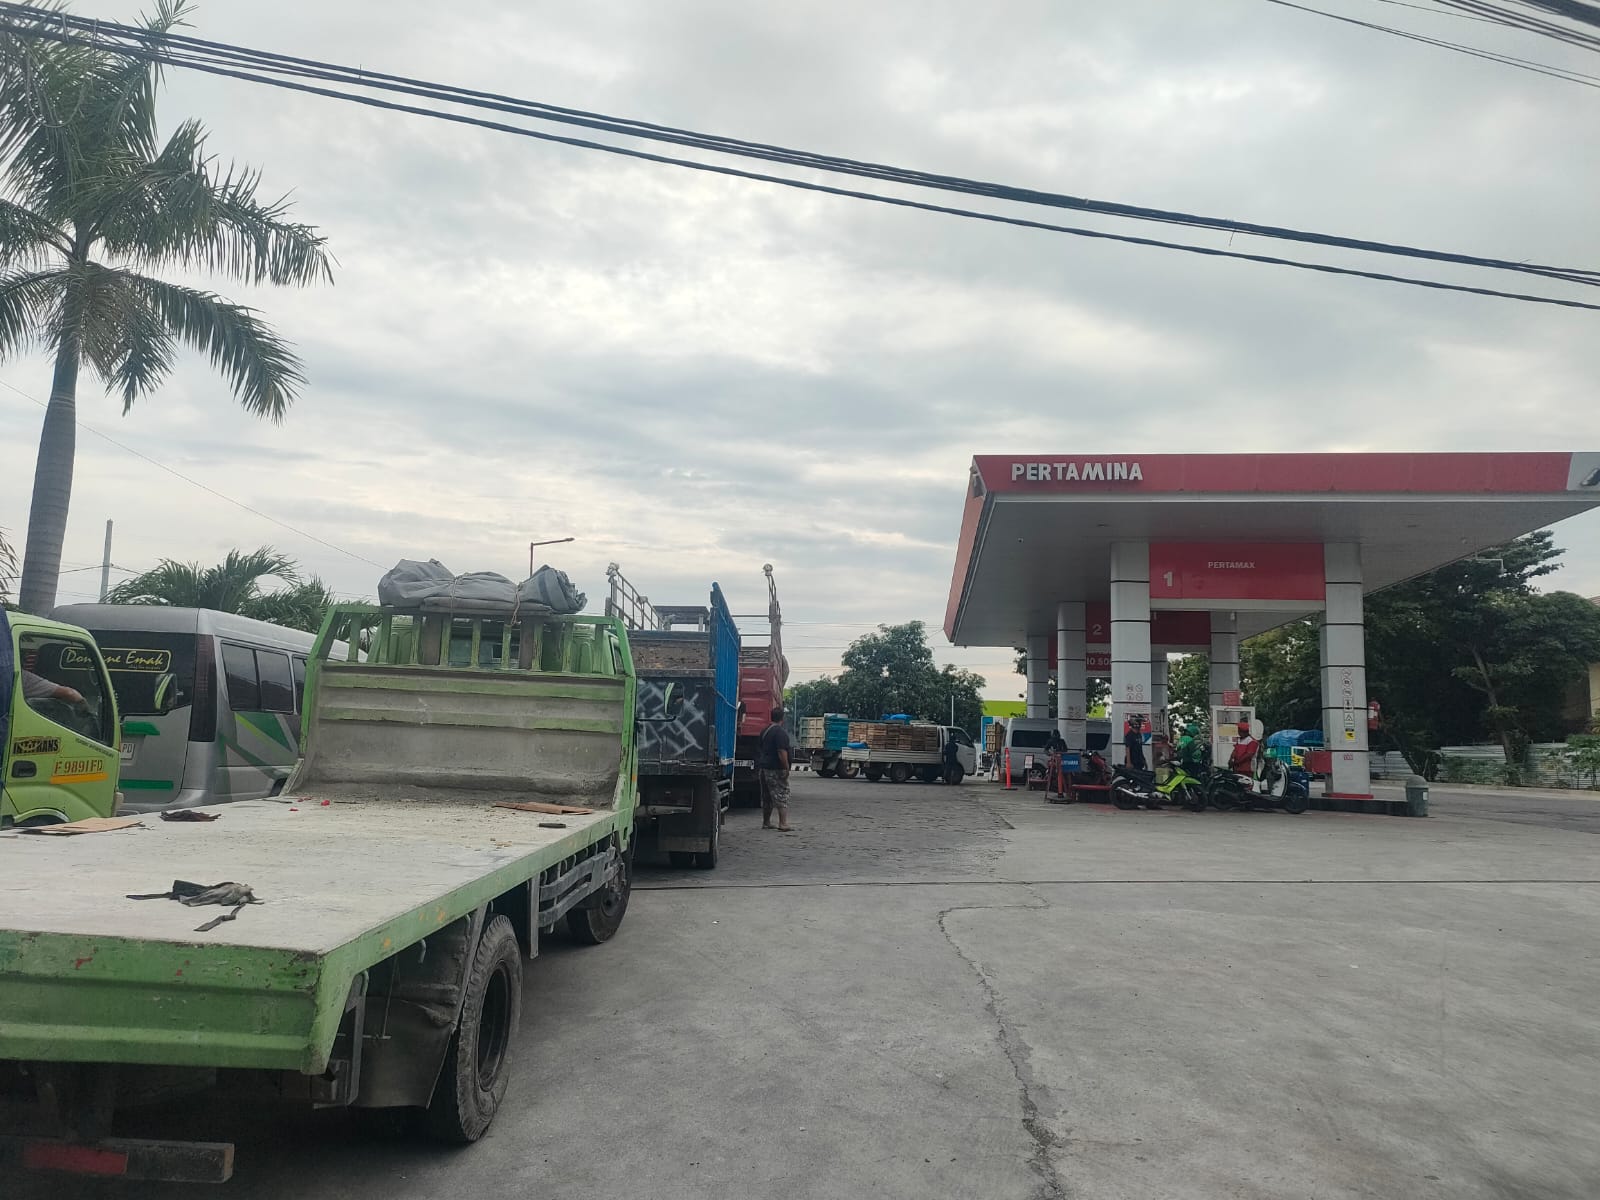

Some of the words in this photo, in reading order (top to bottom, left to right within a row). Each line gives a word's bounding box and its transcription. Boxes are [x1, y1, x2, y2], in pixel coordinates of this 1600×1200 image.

[1011, 462, 1143, 481] PERTAMINA
[1207, 561, 1256, 569] PERTAMAX
[1163, 571, 1173, 587] 1
[1092, 624, 1103, 635] 2
